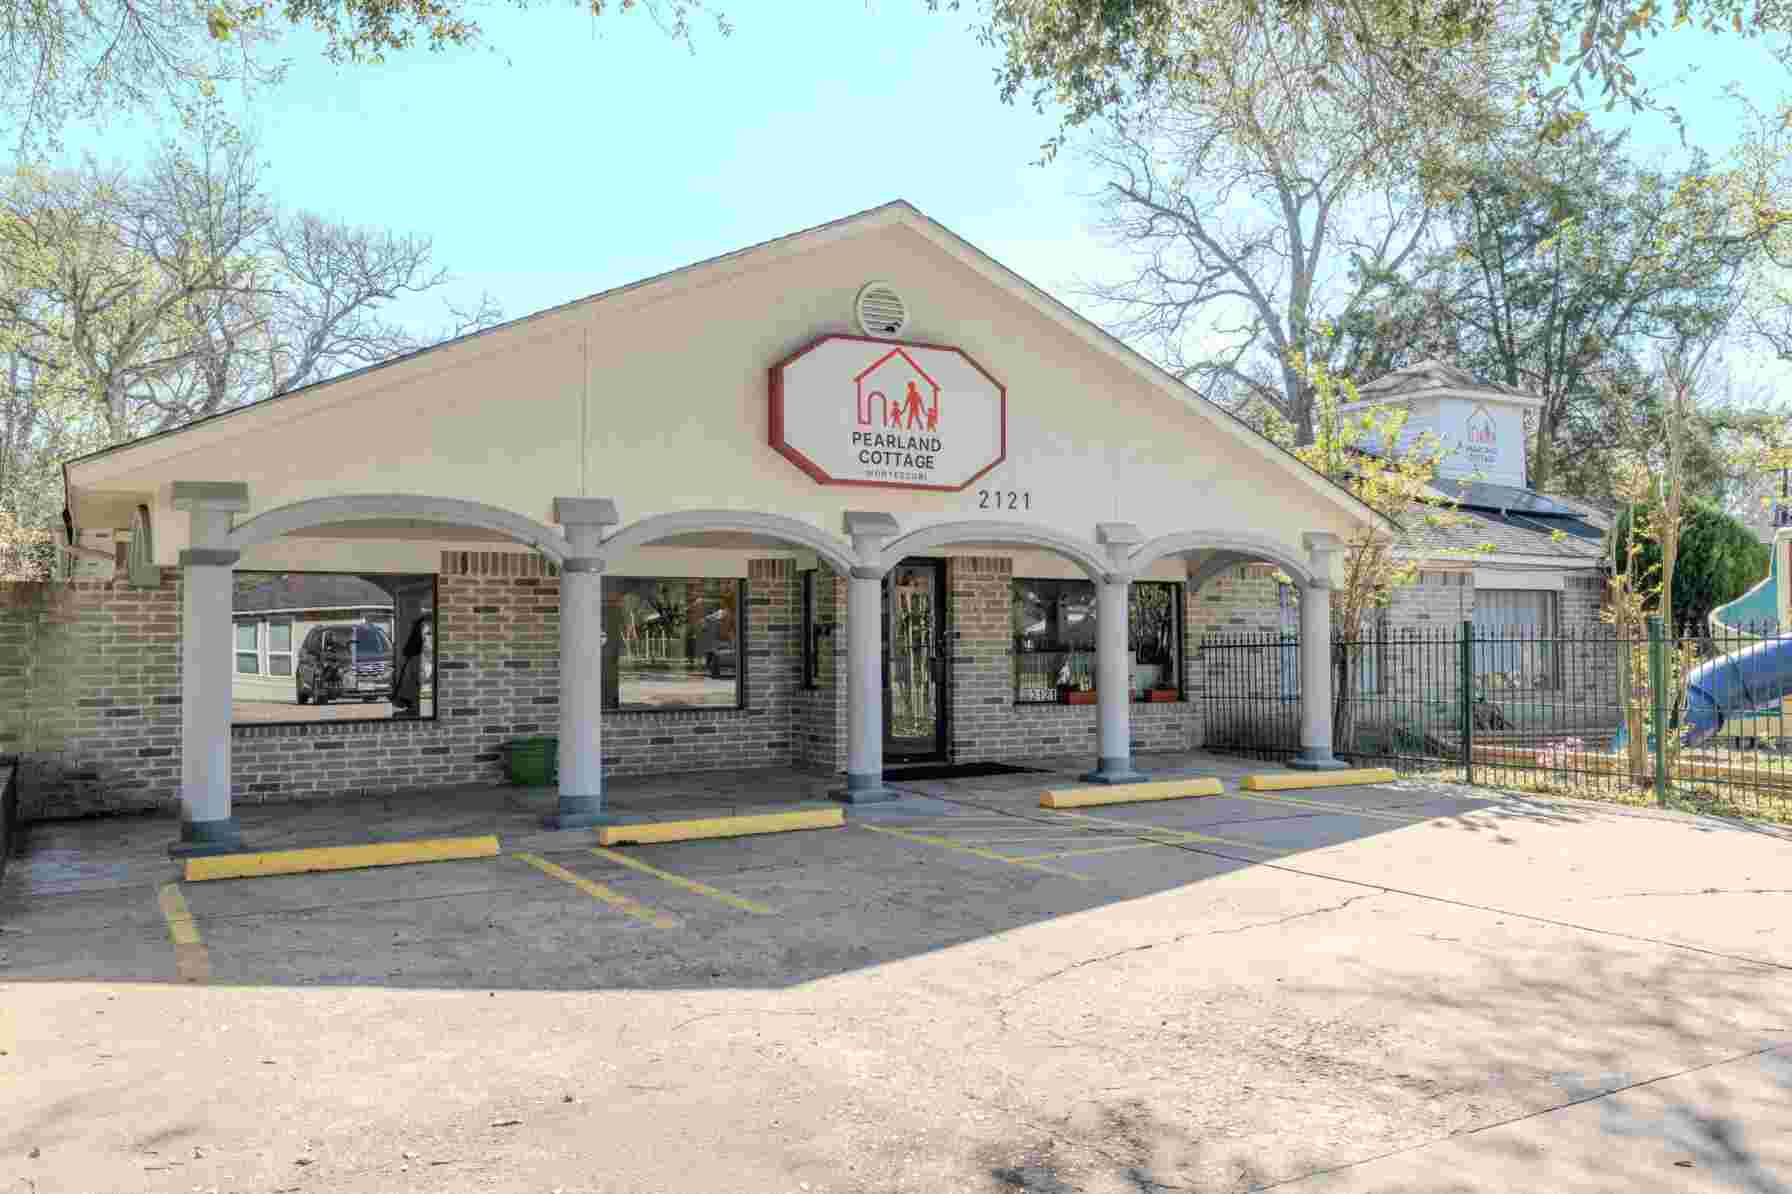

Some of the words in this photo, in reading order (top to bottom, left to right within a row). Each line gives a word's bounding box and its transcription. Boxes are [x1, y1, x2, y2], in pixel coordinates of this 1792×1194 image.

[852, 431, 942, 452] PEARLAND
[859, 449, 935, 470] COTTAGE
[978, 489, 1030, 511] 2121
